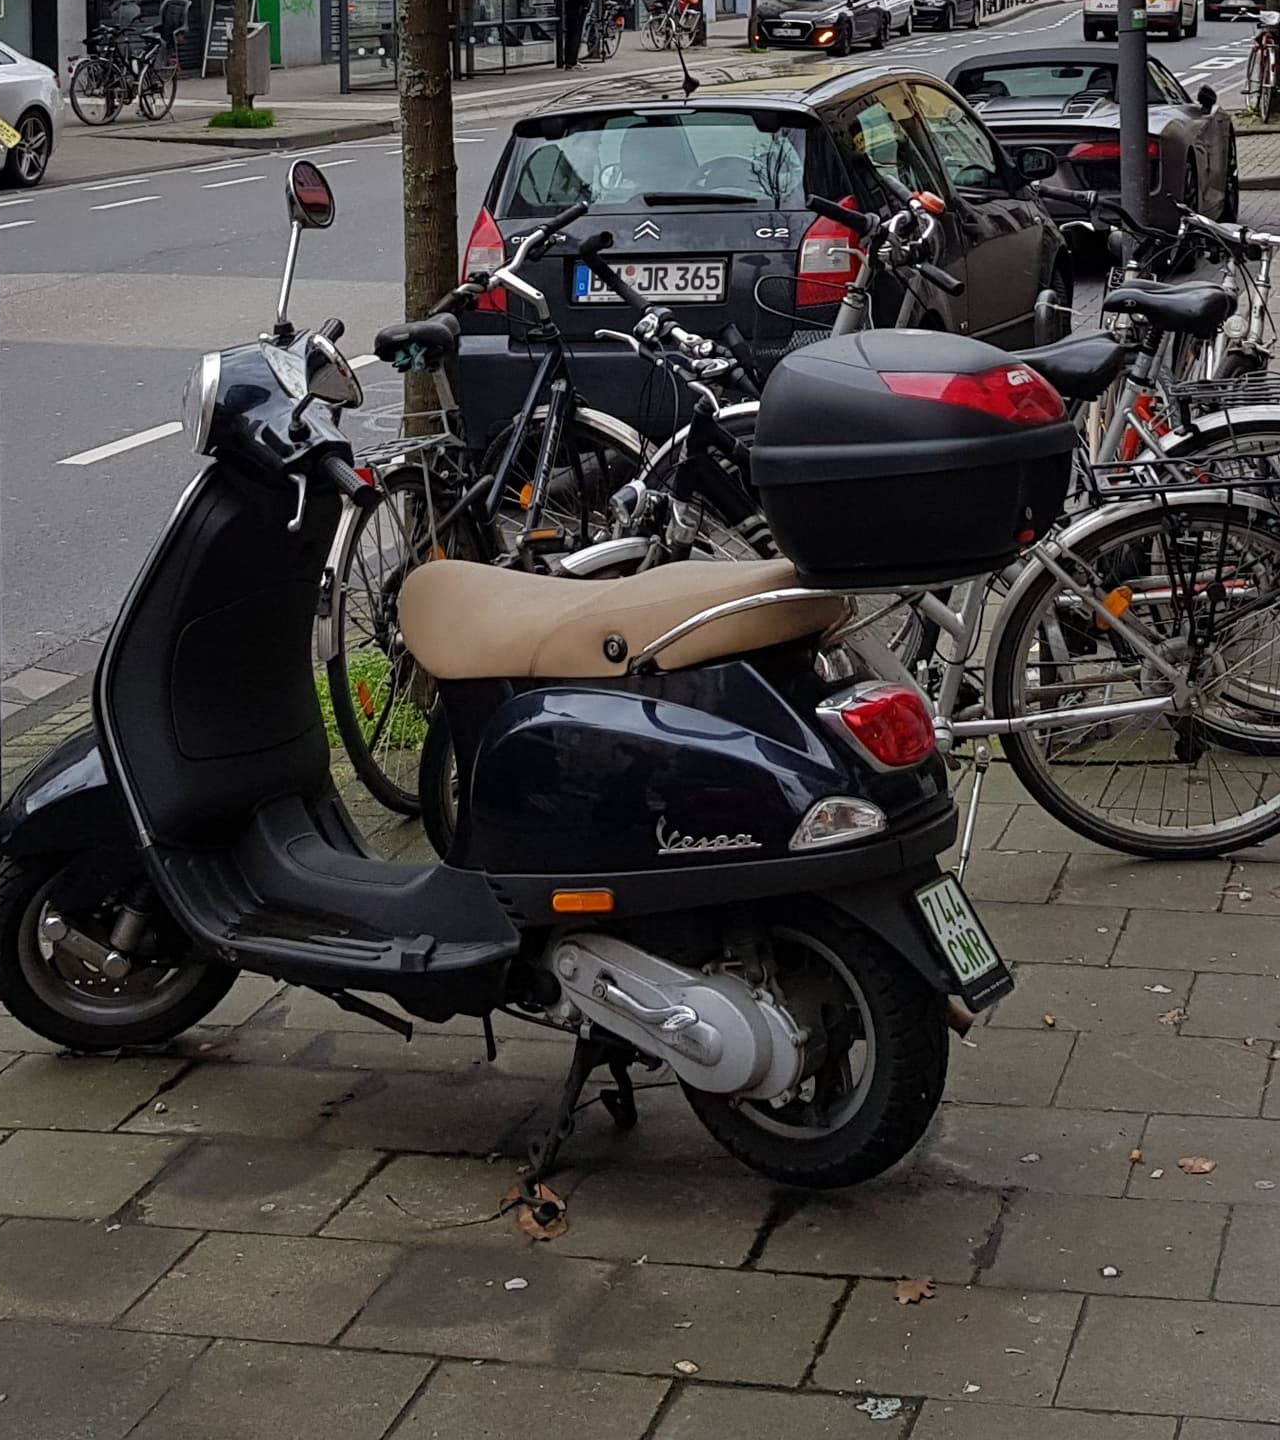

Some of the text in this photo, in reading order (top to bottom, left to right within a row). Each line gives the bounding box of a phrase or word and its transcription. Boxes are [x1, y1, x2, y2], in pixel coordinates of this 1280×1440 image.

[755, 227, 790, 239] C2
[637, 266, 669, 292] JR
[674, 266, 720, 292] 365
[655, 814, 763, 855] Vespa
[921, 884, 967, 935] 744
